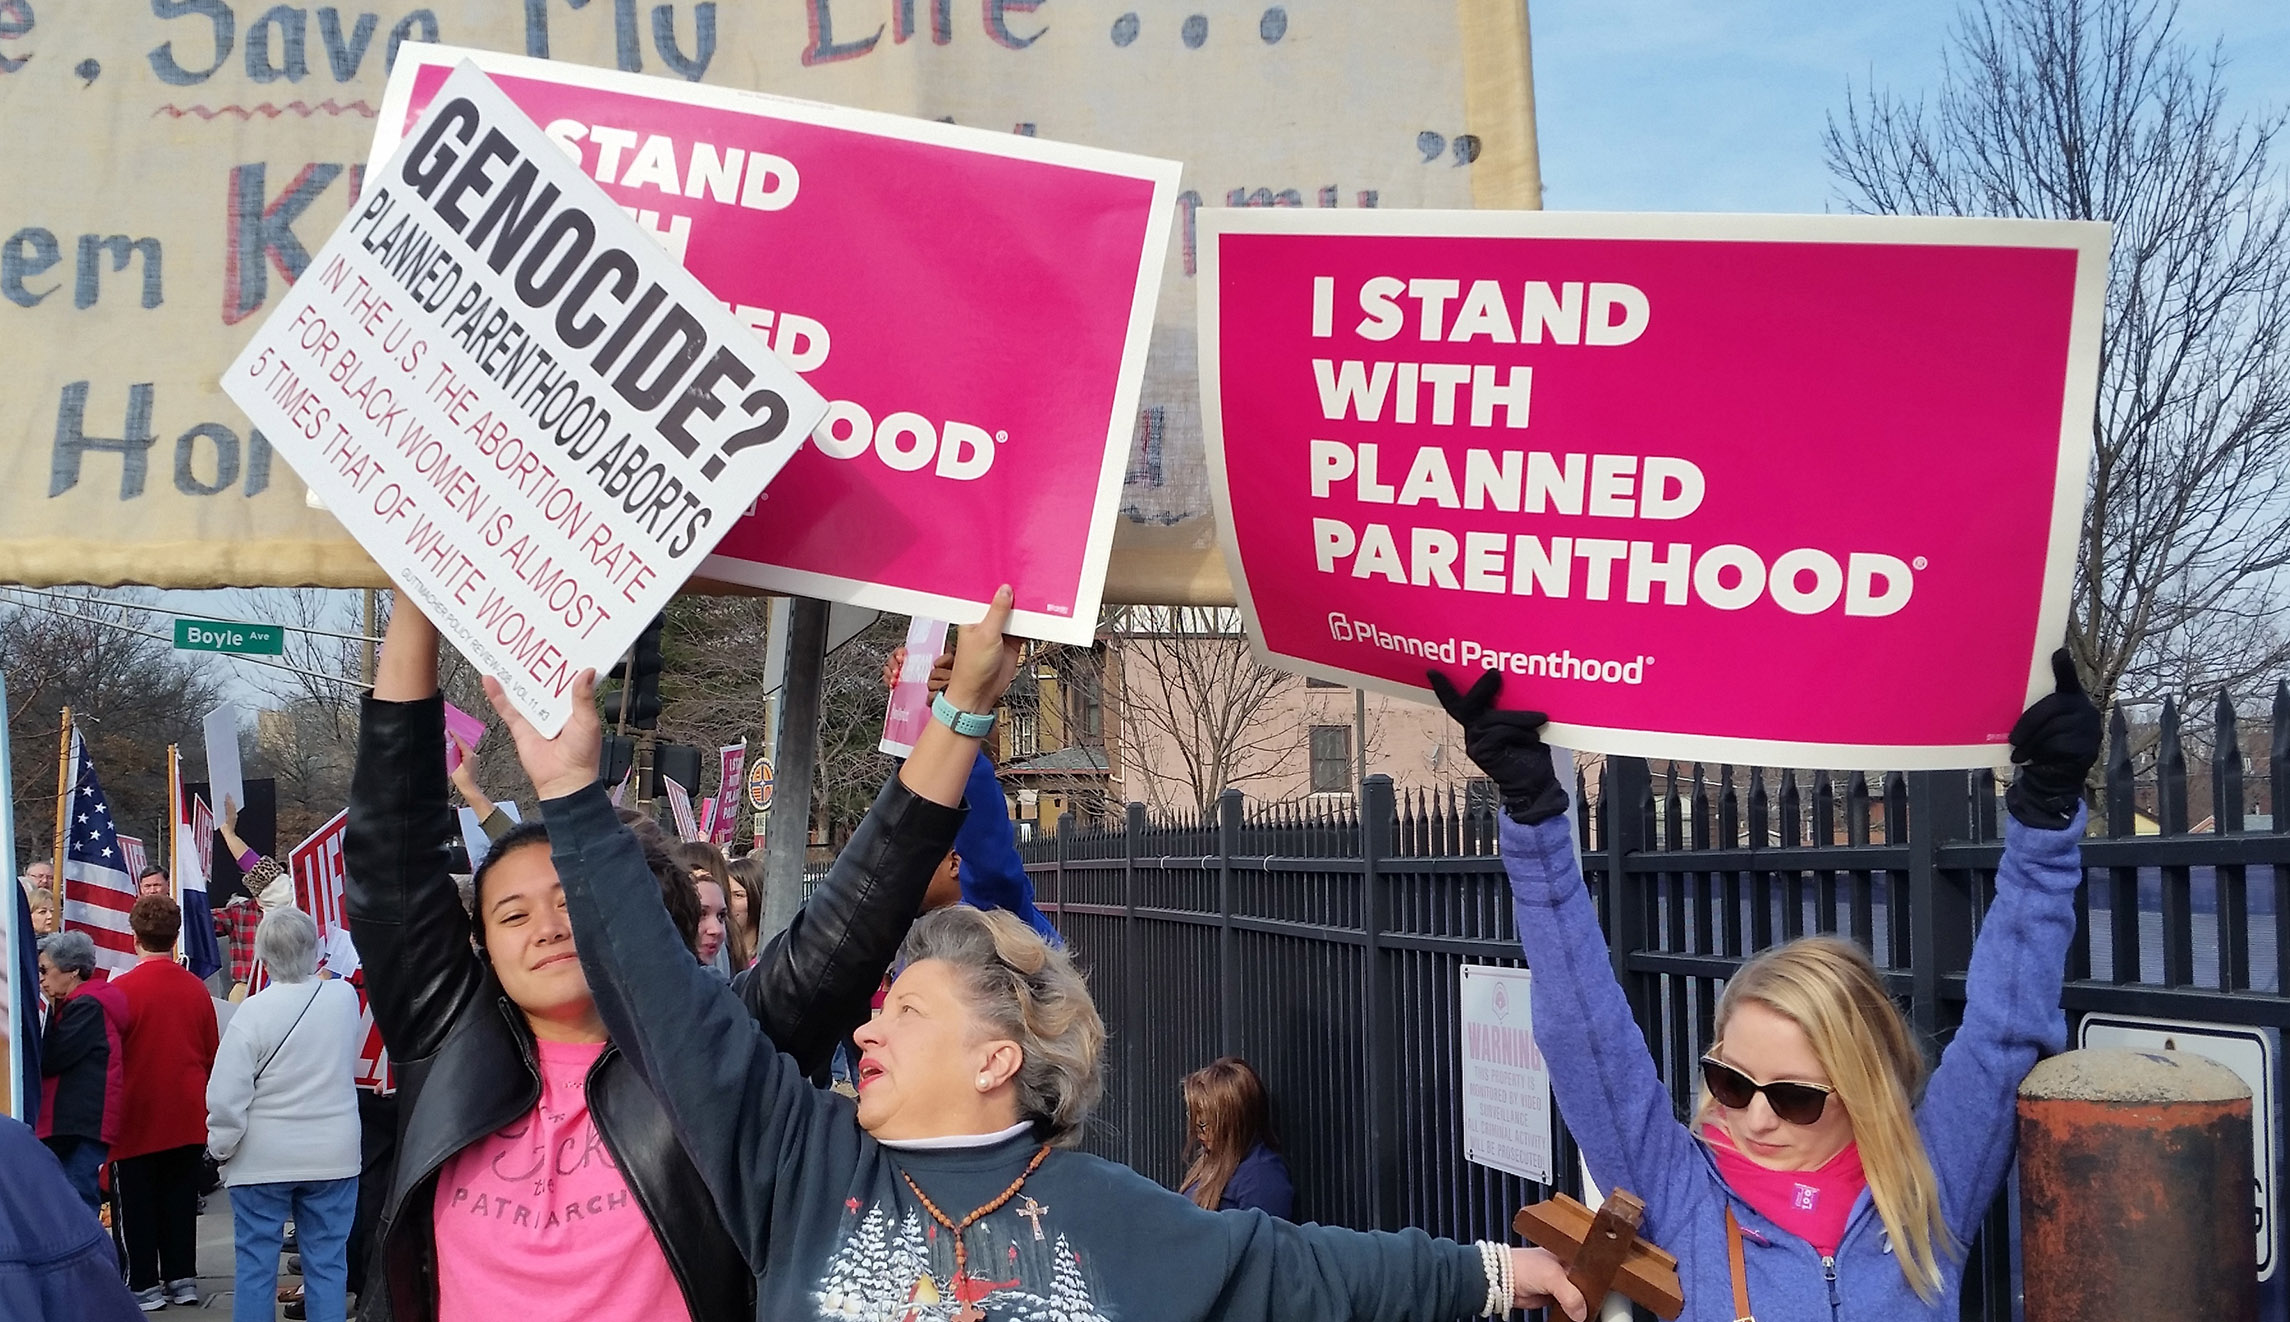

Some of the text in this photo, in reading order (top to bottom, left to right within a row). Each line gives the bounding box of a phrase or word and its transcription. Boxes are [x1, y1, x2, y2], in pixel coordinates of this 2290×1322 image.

[544, 118, 801, 211] STAND
[402, 97, 790, 483] GENOCIDE?
[1312, 276, 1651, 346] I STAND
[351, 190, 713, 559] PLANNED PARENTHOOD ABORTS
[1311, 358, 1533, 428] WITH
[319, 253, 656, 604] IN THE U.S. THE ABORTION RATE
[288, 304, 611, 640] FOR BLACK WOMEN IS ALMOST
[1310, 439, 1706, 521] PLANNED
[250, 347, 578, 699] 5 TIMES THAT OF WHITE WOMEN
[187, 626, 270, 648] Boyle Ave
[401, 567, 448, 618] GUTTMACHER
[445, 613, 472, 642] POLICY
[1355, 620, 1456, 665] Planned
[1467, 1022, 1541, 1072] WARNING
[1474, 1066, 1536, 1090] THIS PROPERTY IS
[1469, 1083, 1542, 1111] MONITORED BY VIDEO
[1479, 1103, 1528, 1127] SURVEILLANCE
[1468, 1118, 1546, 1150] ALL CRIMINAL ACTIVITY
[1470, 1136, 1485, 1153] WILL
[1487, 1141, 1495, 1155] BE
[451, 1188, 628, 1229] PATRIARCH
